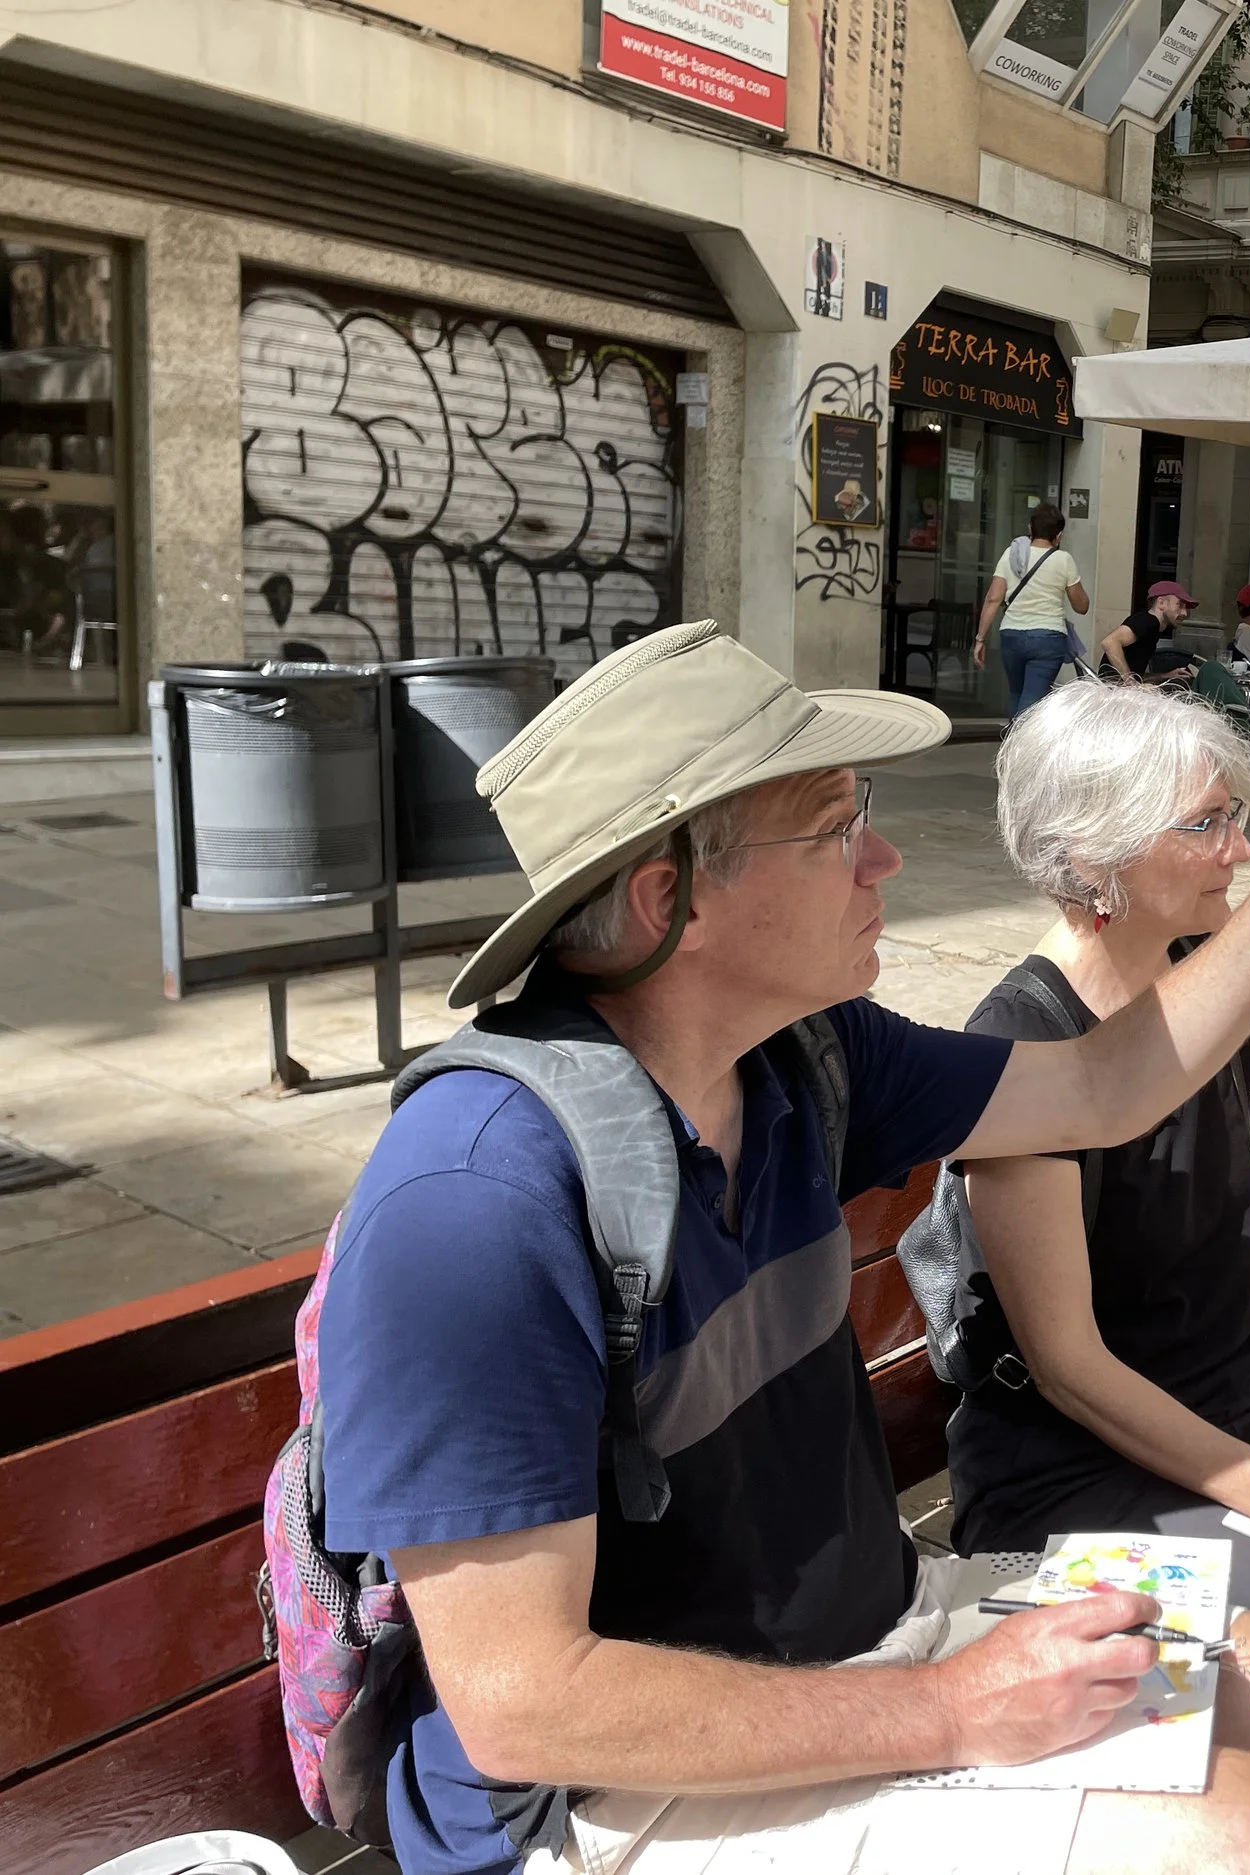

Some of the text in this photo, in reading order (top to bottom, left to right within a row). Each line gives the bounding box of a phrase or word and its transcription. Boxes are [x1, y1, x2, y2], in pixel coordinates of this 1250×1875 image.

[1163, 36, 1198, 57] COWORKING
[1177, 25, 1199, 42] TRADEL
[621, 35, 771, 97] www.tradel-barcelona.com
[995, 55, 1062, 91] COWORKING
[1164, 51, 1180, 63] SPACE
[915, 323, 1051, 382] TERRA BAR
[922, 376, 1040, 419] LLOC DE TROBADA
